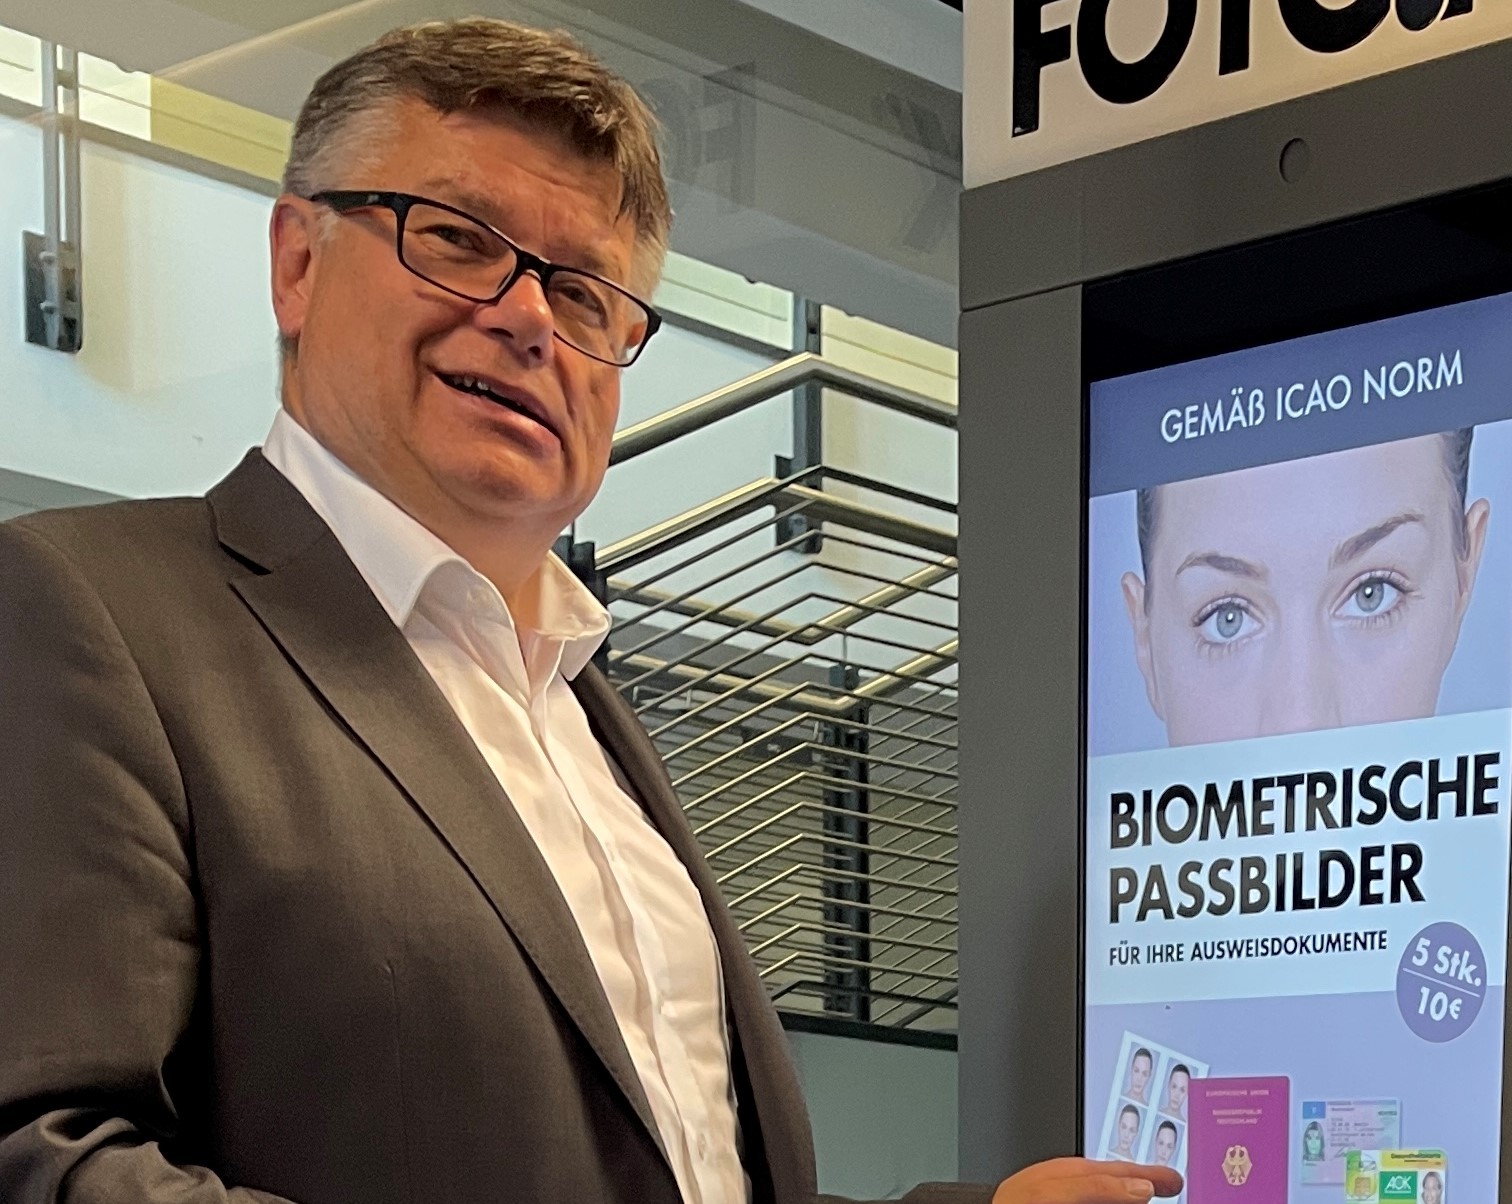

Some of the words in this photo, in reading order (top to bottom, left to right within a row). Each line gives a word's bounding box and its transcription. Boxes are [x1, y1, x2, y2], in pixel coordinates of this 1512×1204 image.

[1275, 374, 1351, 421] ICAO
[1363, 350, 1464, 404] NORM
[1109, 751, 1501, 850] BIOMETRISCHE
[1109, 842, 1426, 924] PASSBILDER
[1109, 940, 1141, 966] FÜR
[1146, 942, 1185, 963] IHRE
[1190, 930, 1388, 961] AUSWEISDOKUMENTE
[1411, 937, 1430, 967] 5
[1433, 946, 1482, 987] Stk.
